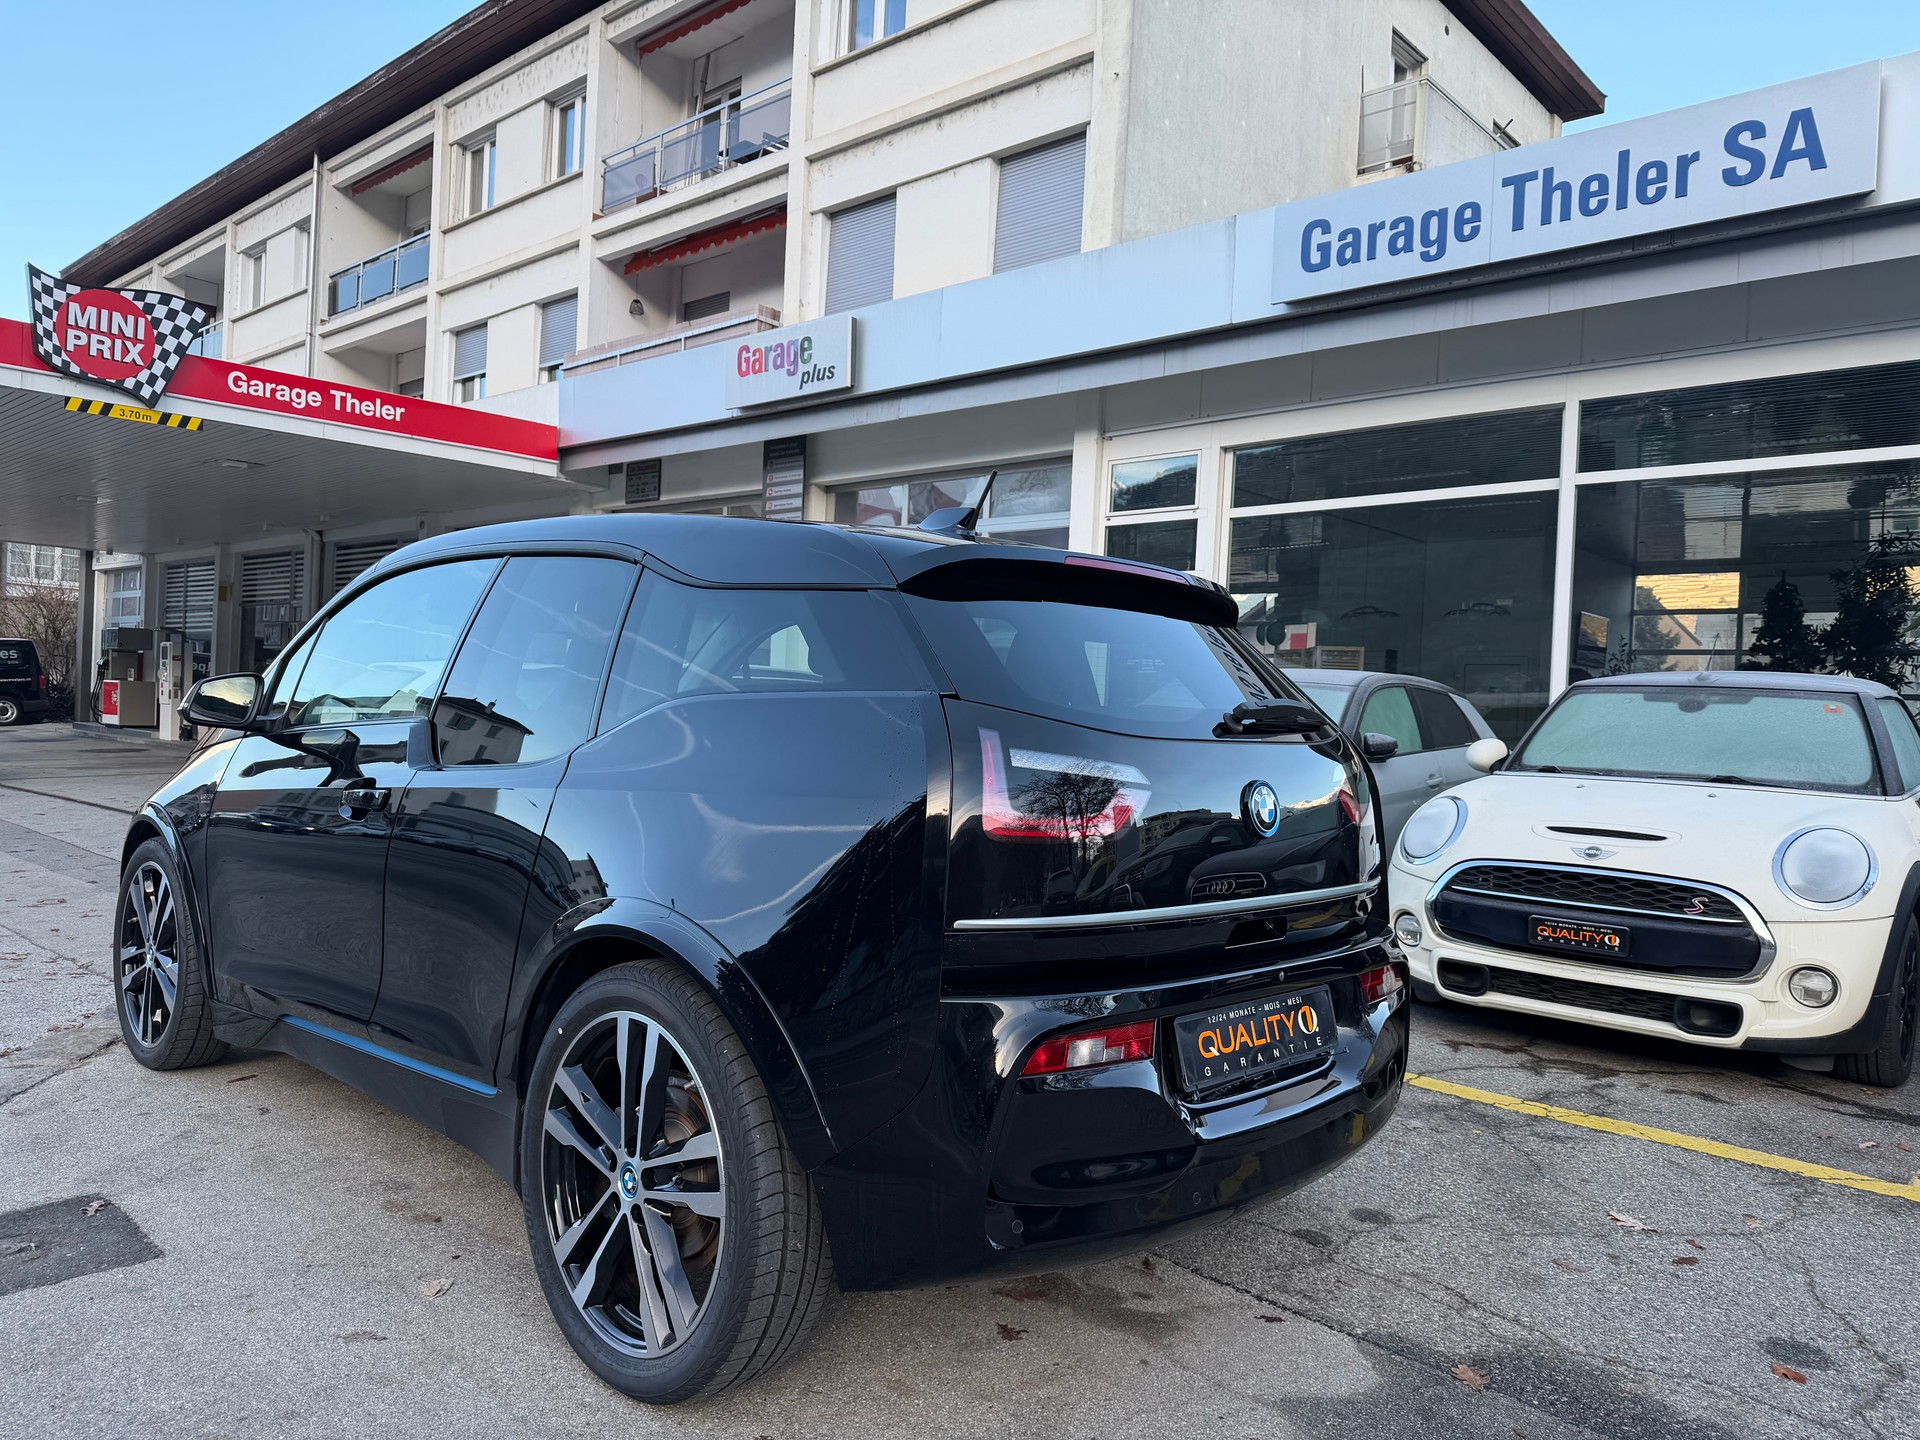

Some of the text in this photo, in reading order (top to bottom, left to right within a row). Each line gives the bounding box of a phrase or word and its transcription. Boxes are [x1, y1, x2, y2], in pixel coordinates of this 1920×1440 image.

[1301, 107, 1827, 273] Garage Theler SA
[67, 301, 145, 341] MINI
[66, 329, 145, 366] PRIX
[737, 336, 813, 378] Garage
[799, 363, 836, 390] plus
[227, 371, 405, 422] Garage Theler
[0, 650, 18, 659] es
[1537, 925, 1604, 943] QUALITY
[1537, 935, 1619, 952] GARANTIE
[1207, 1014, 1227, 1024] 12/24
[1229, 1006, 1256, 1019] MONATE
[1263, 1001, 1280, 1011] MOIS
[1287, 996, 1303, 1006] MESI
[1198, 1011, 1295, 1059] QUALITY
[1204, 1036, 1322, 1077] GARANTIE
